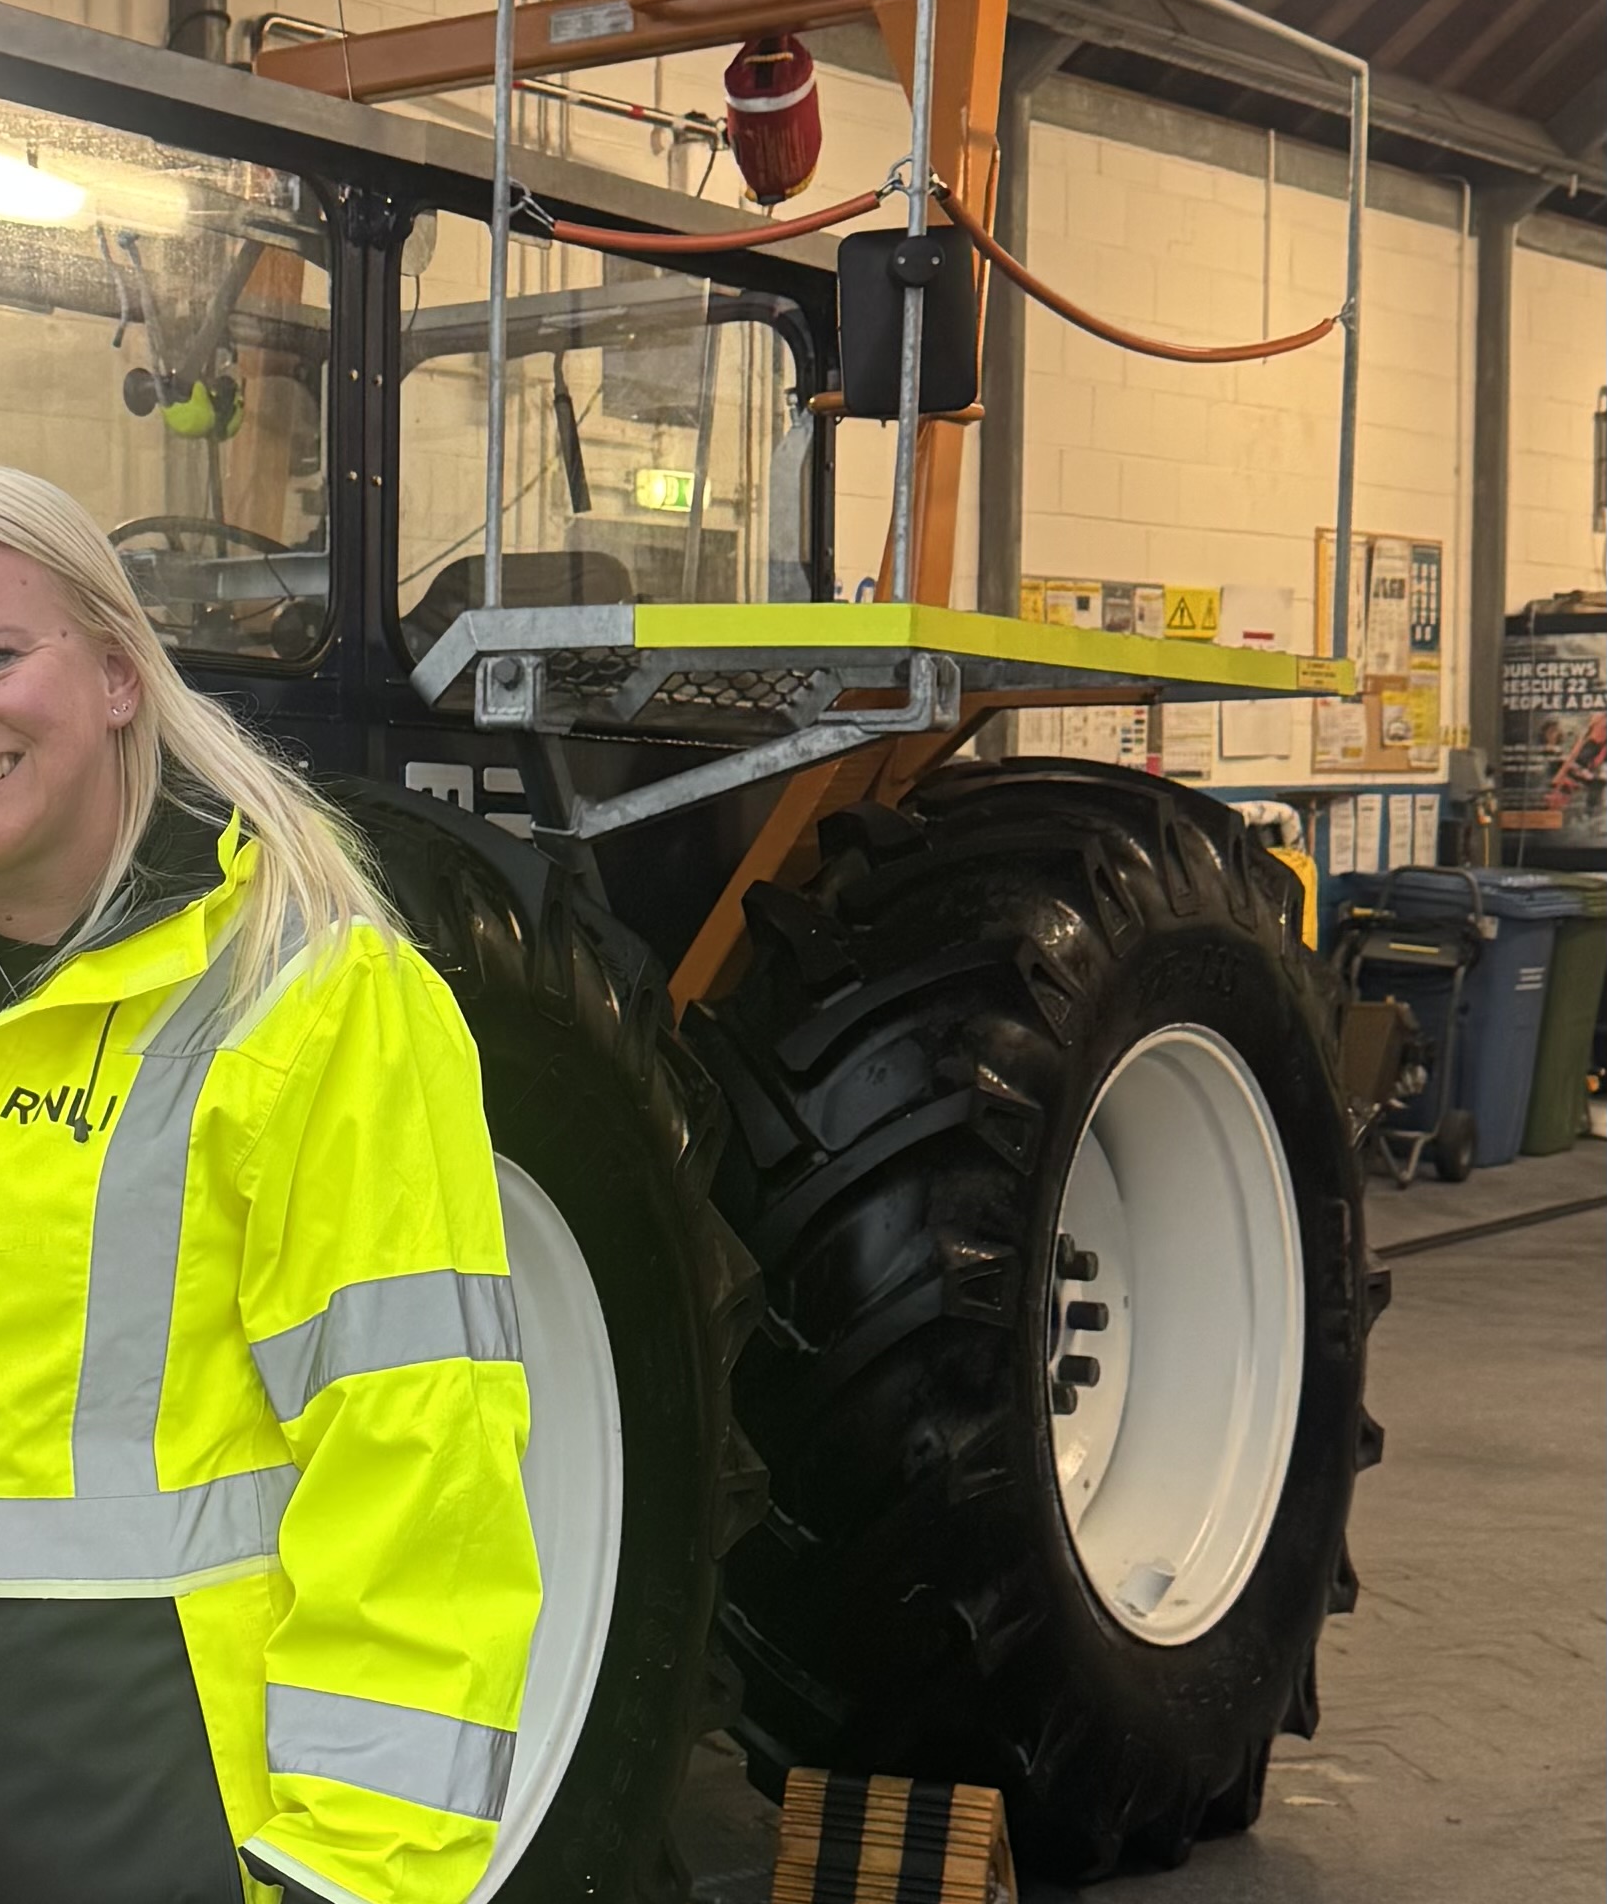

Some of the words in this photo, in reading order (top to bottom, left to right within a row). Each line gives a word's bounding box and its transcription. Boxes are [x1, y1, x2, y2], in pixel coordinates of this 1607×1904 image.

[1536, 662, 1597, 677] CREWS
[1566, 678, 1588, 693] 22
[1565, 695, 1579, 709] A
[1581, 693, 1607, 709] DA
[0, 1085, 118, 1132] RNLI
